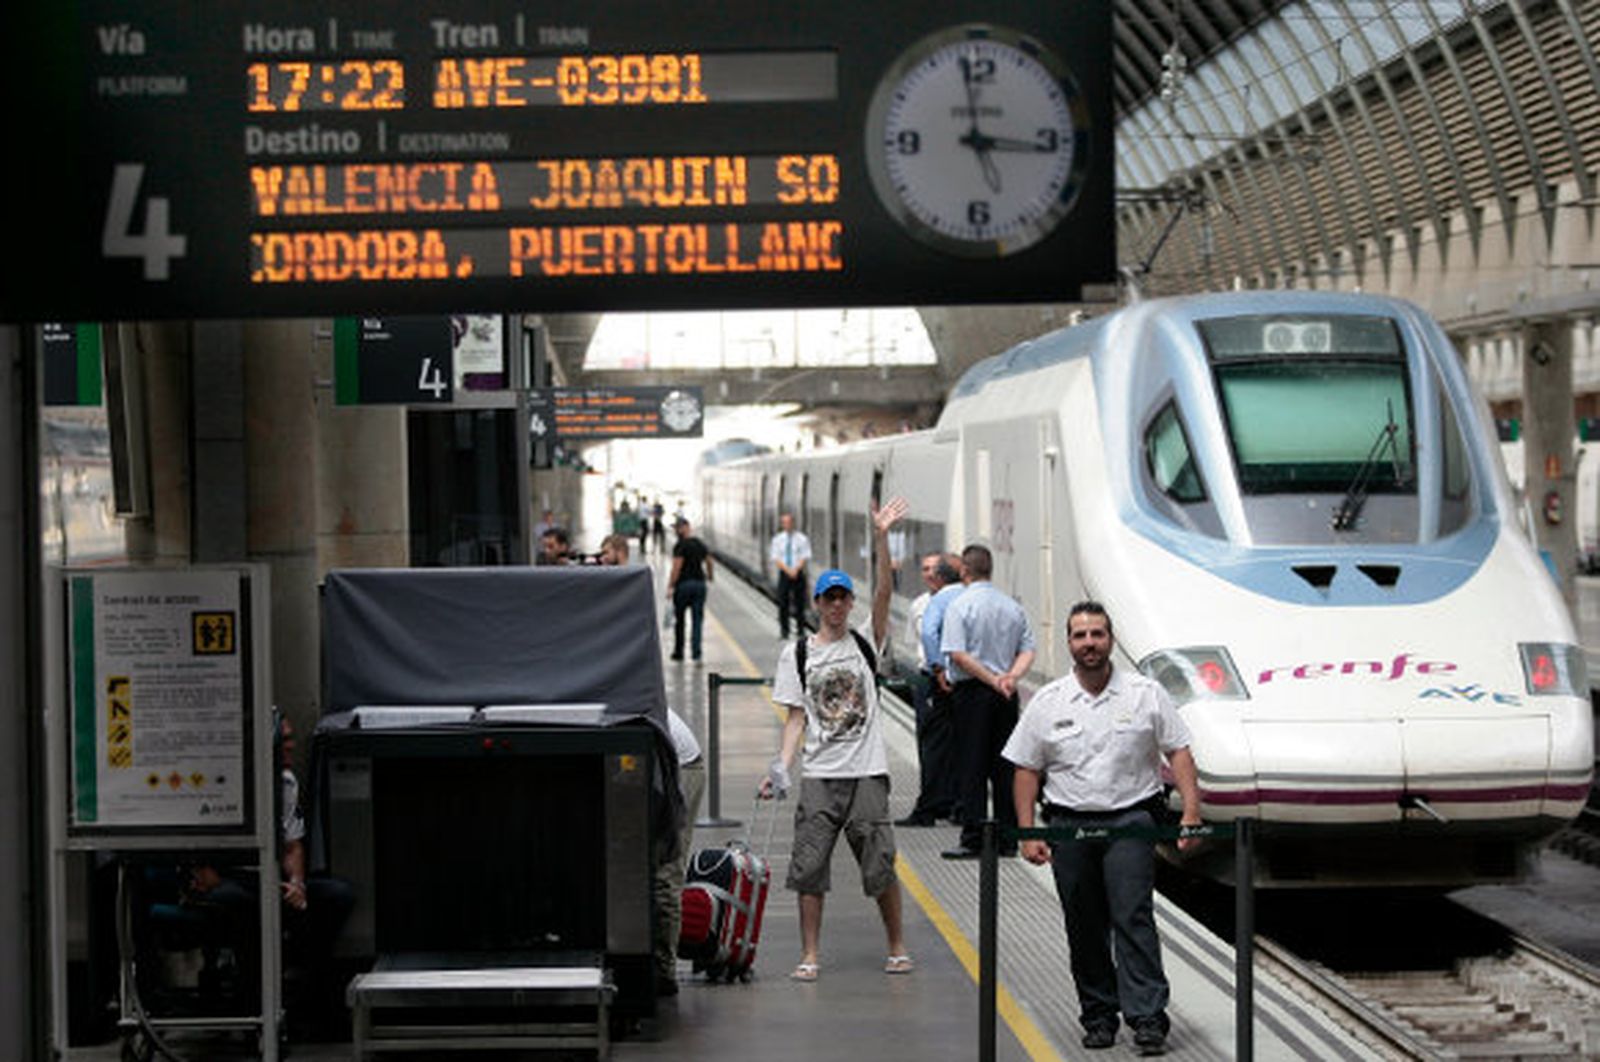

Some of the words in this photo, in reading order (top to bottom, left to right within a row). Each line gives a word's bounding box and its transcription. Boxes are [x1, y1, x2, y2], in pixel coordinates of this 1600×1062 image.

[98, 24, 145, 55] Vía
[244, 22, 315, 52] Hora
[351, 31, 394, 50] TIME
[431, 19, 500, 49] Tren
[537, 26, 589, 46] TRAIN
[247, 61, 404, 112] 17:22
[433, 54, 706, 109] AVE-03981
[245, 123, 361, 154] Destino
[399, 131, 510, 153] DESTINATION
[250, 161, 499, 217] VALENCIA
[530, 156, 748, 212] JOAQUIN
[776, 154, 841, 206] SO
[102, 163, 188, 281] 4
[418, 357, 448, 399] 4
[530, 413, 548, 436] 4
[1258, 653, 1457, 684] renfe
